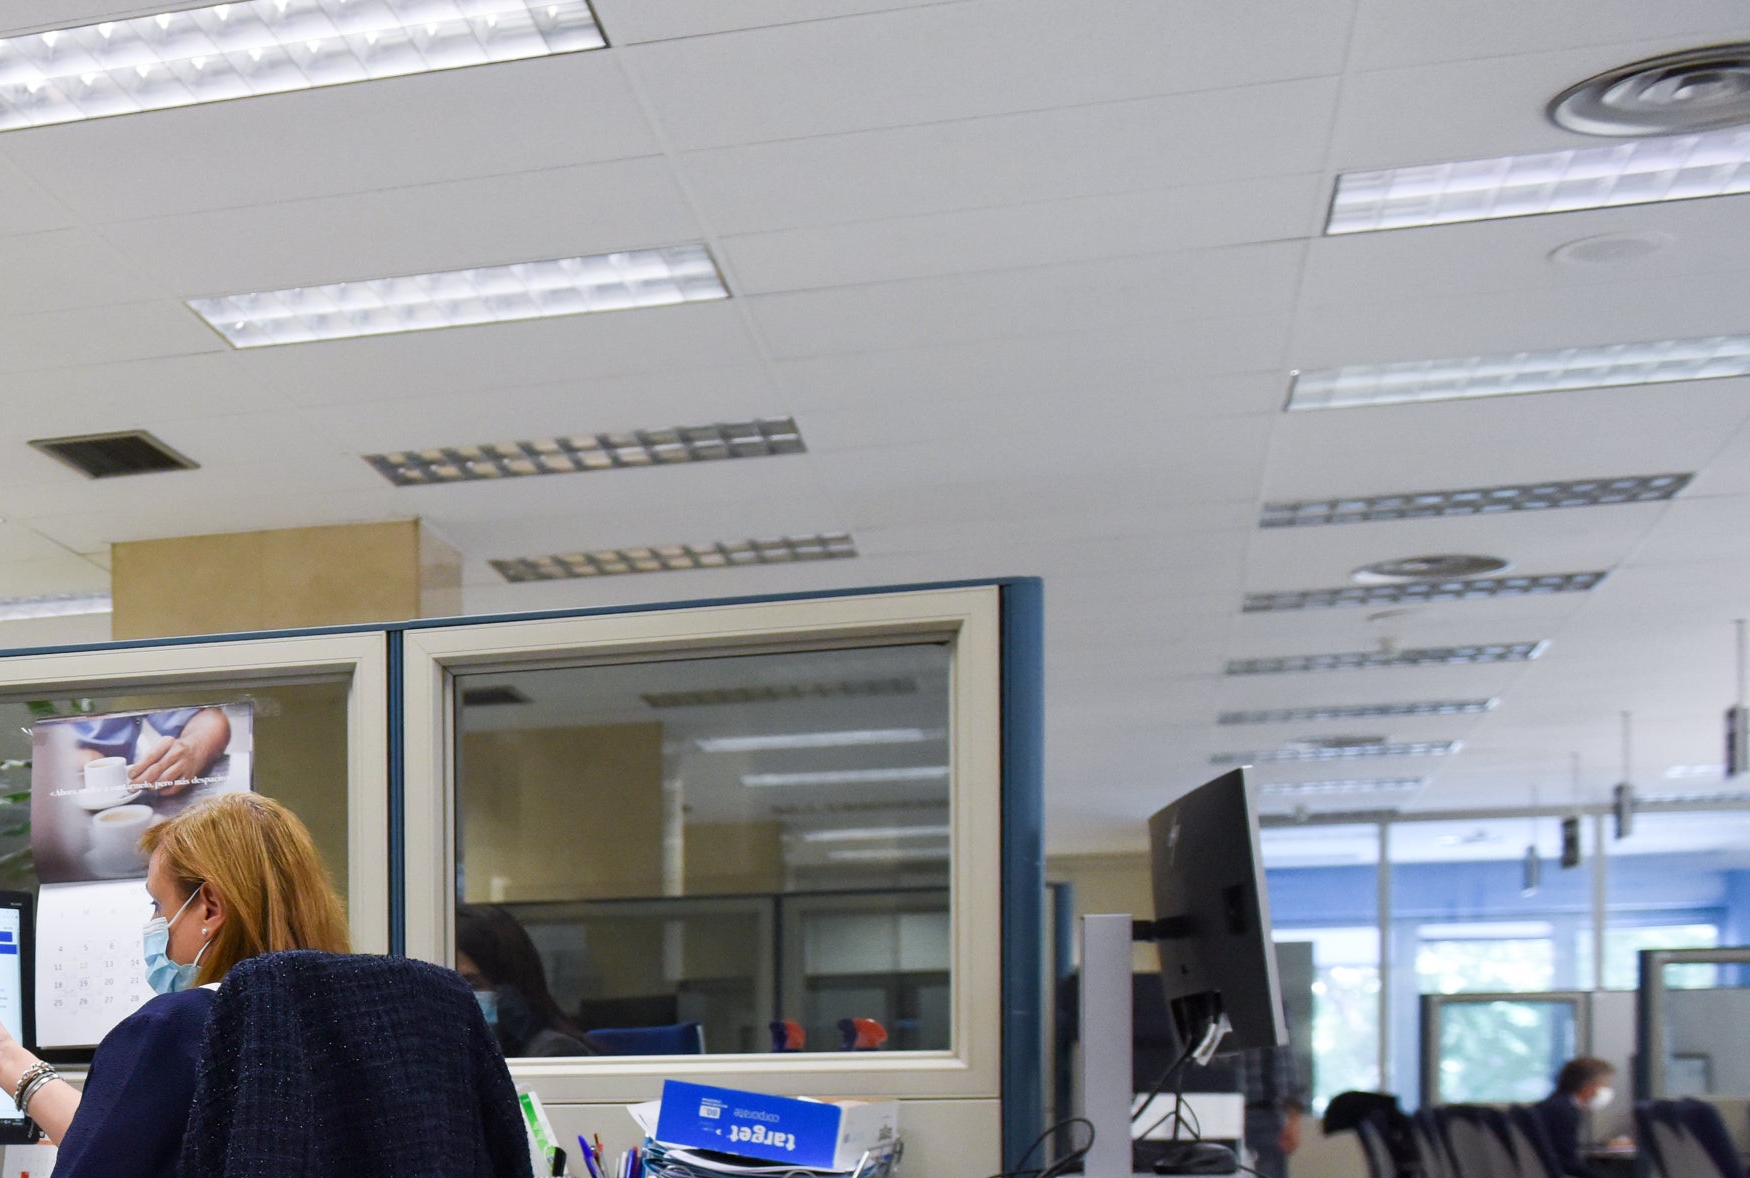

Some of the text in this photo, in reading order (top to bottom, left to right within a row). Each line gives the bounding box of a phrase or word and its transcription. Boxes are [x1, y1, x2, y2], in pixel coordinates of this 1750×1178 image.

[155, 780, 173, 789] pero
[174, 777, 190, 786] más
[109, 942, 114, 950] 6
[54, 963, 62, 971] 11
[105, 960, 114, 968] 13
[54, 981, 63, 989] 18
[54, 994, 139, 1007] 25 26 27 28
[734, 1107, 781, 1123] corporate
[730, 1124, 796, 1152] target
